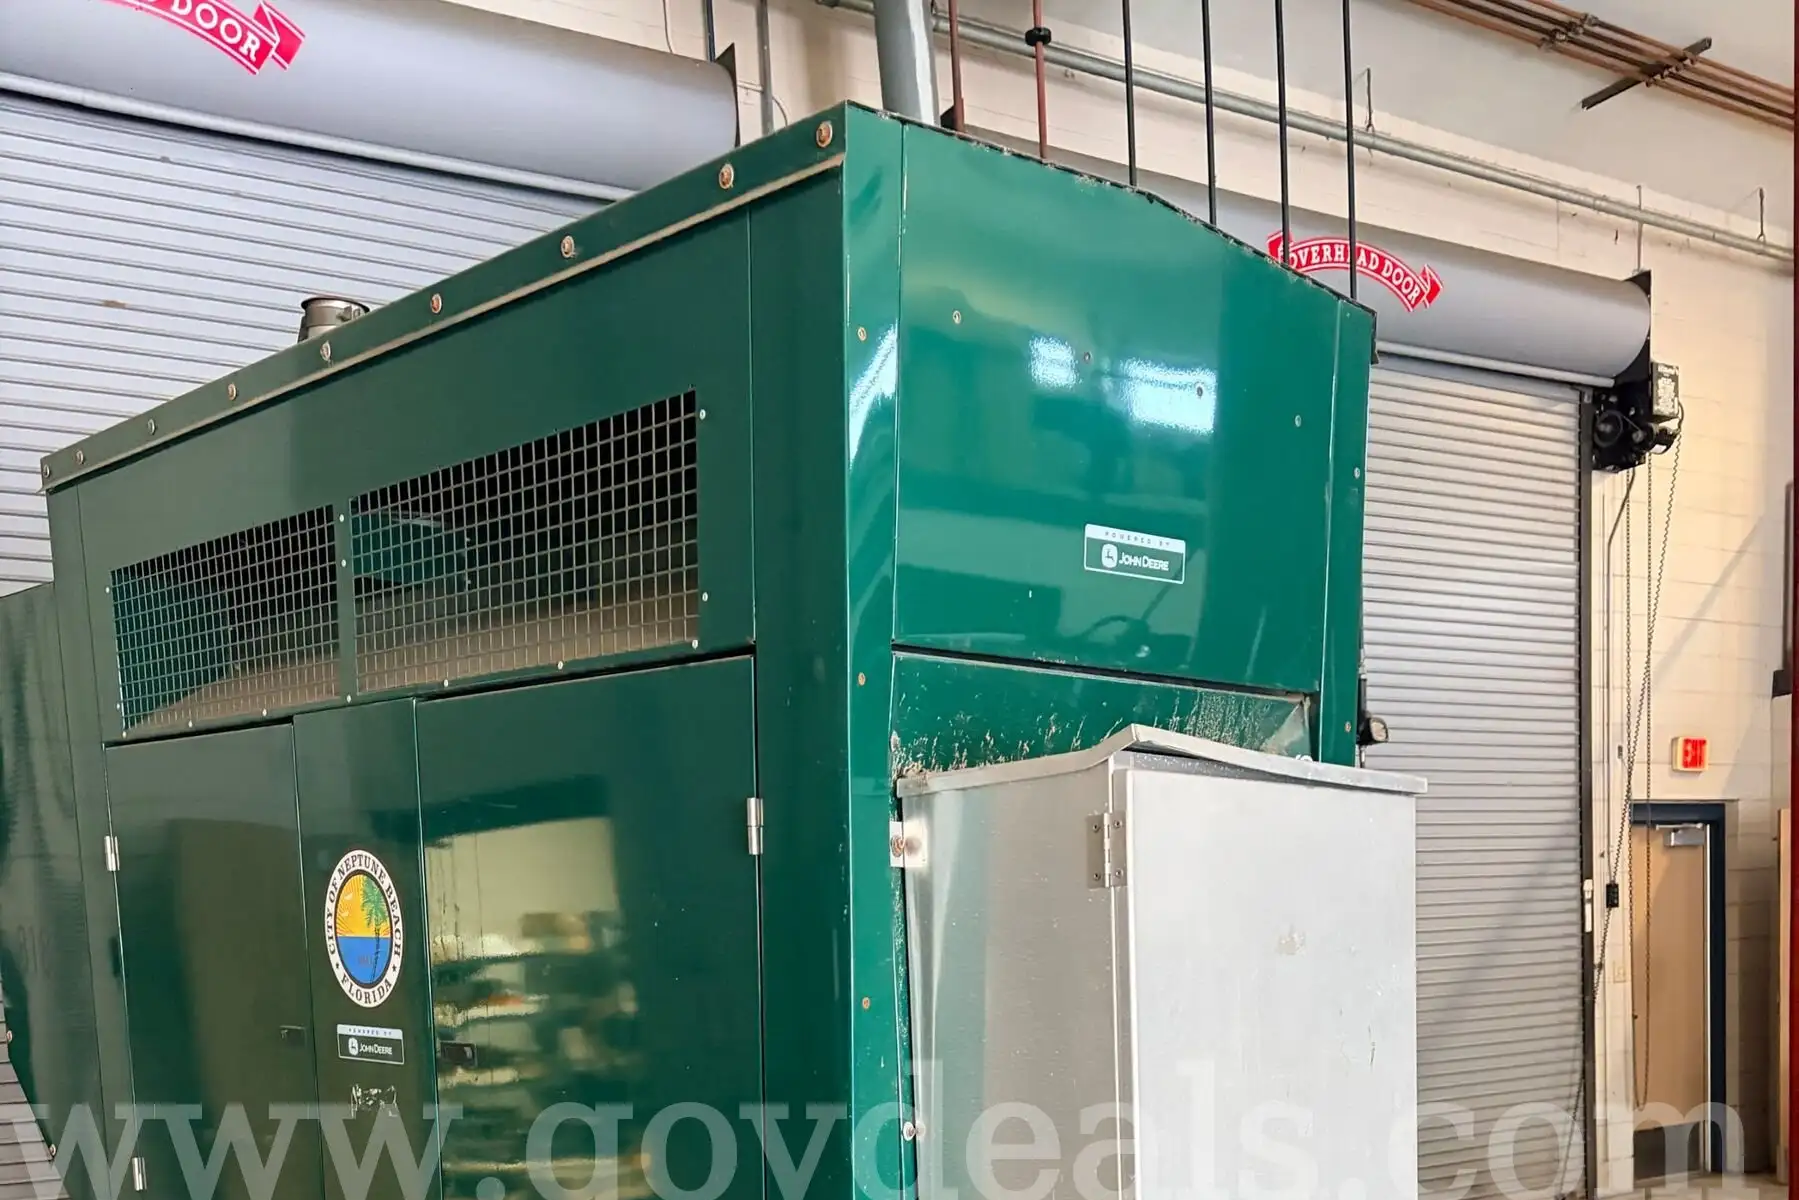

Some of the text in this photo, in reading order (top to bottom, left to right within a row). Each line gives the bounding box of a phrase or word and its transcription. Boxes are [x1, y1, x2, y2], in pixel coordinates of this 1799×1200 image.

[171, 0, 261, 62] DOOR
[1289, 244, 1421, 305] OVERHAD DOOR
[1119, 552, 1169, 571] JOHN DEERE
[326, 854, 402, 957] CITY OF NEPTUNE BEACH
[341, 974, 392, 1005] FLORIDA
[360, 1043, 393, 1055] JOHN DEERE
